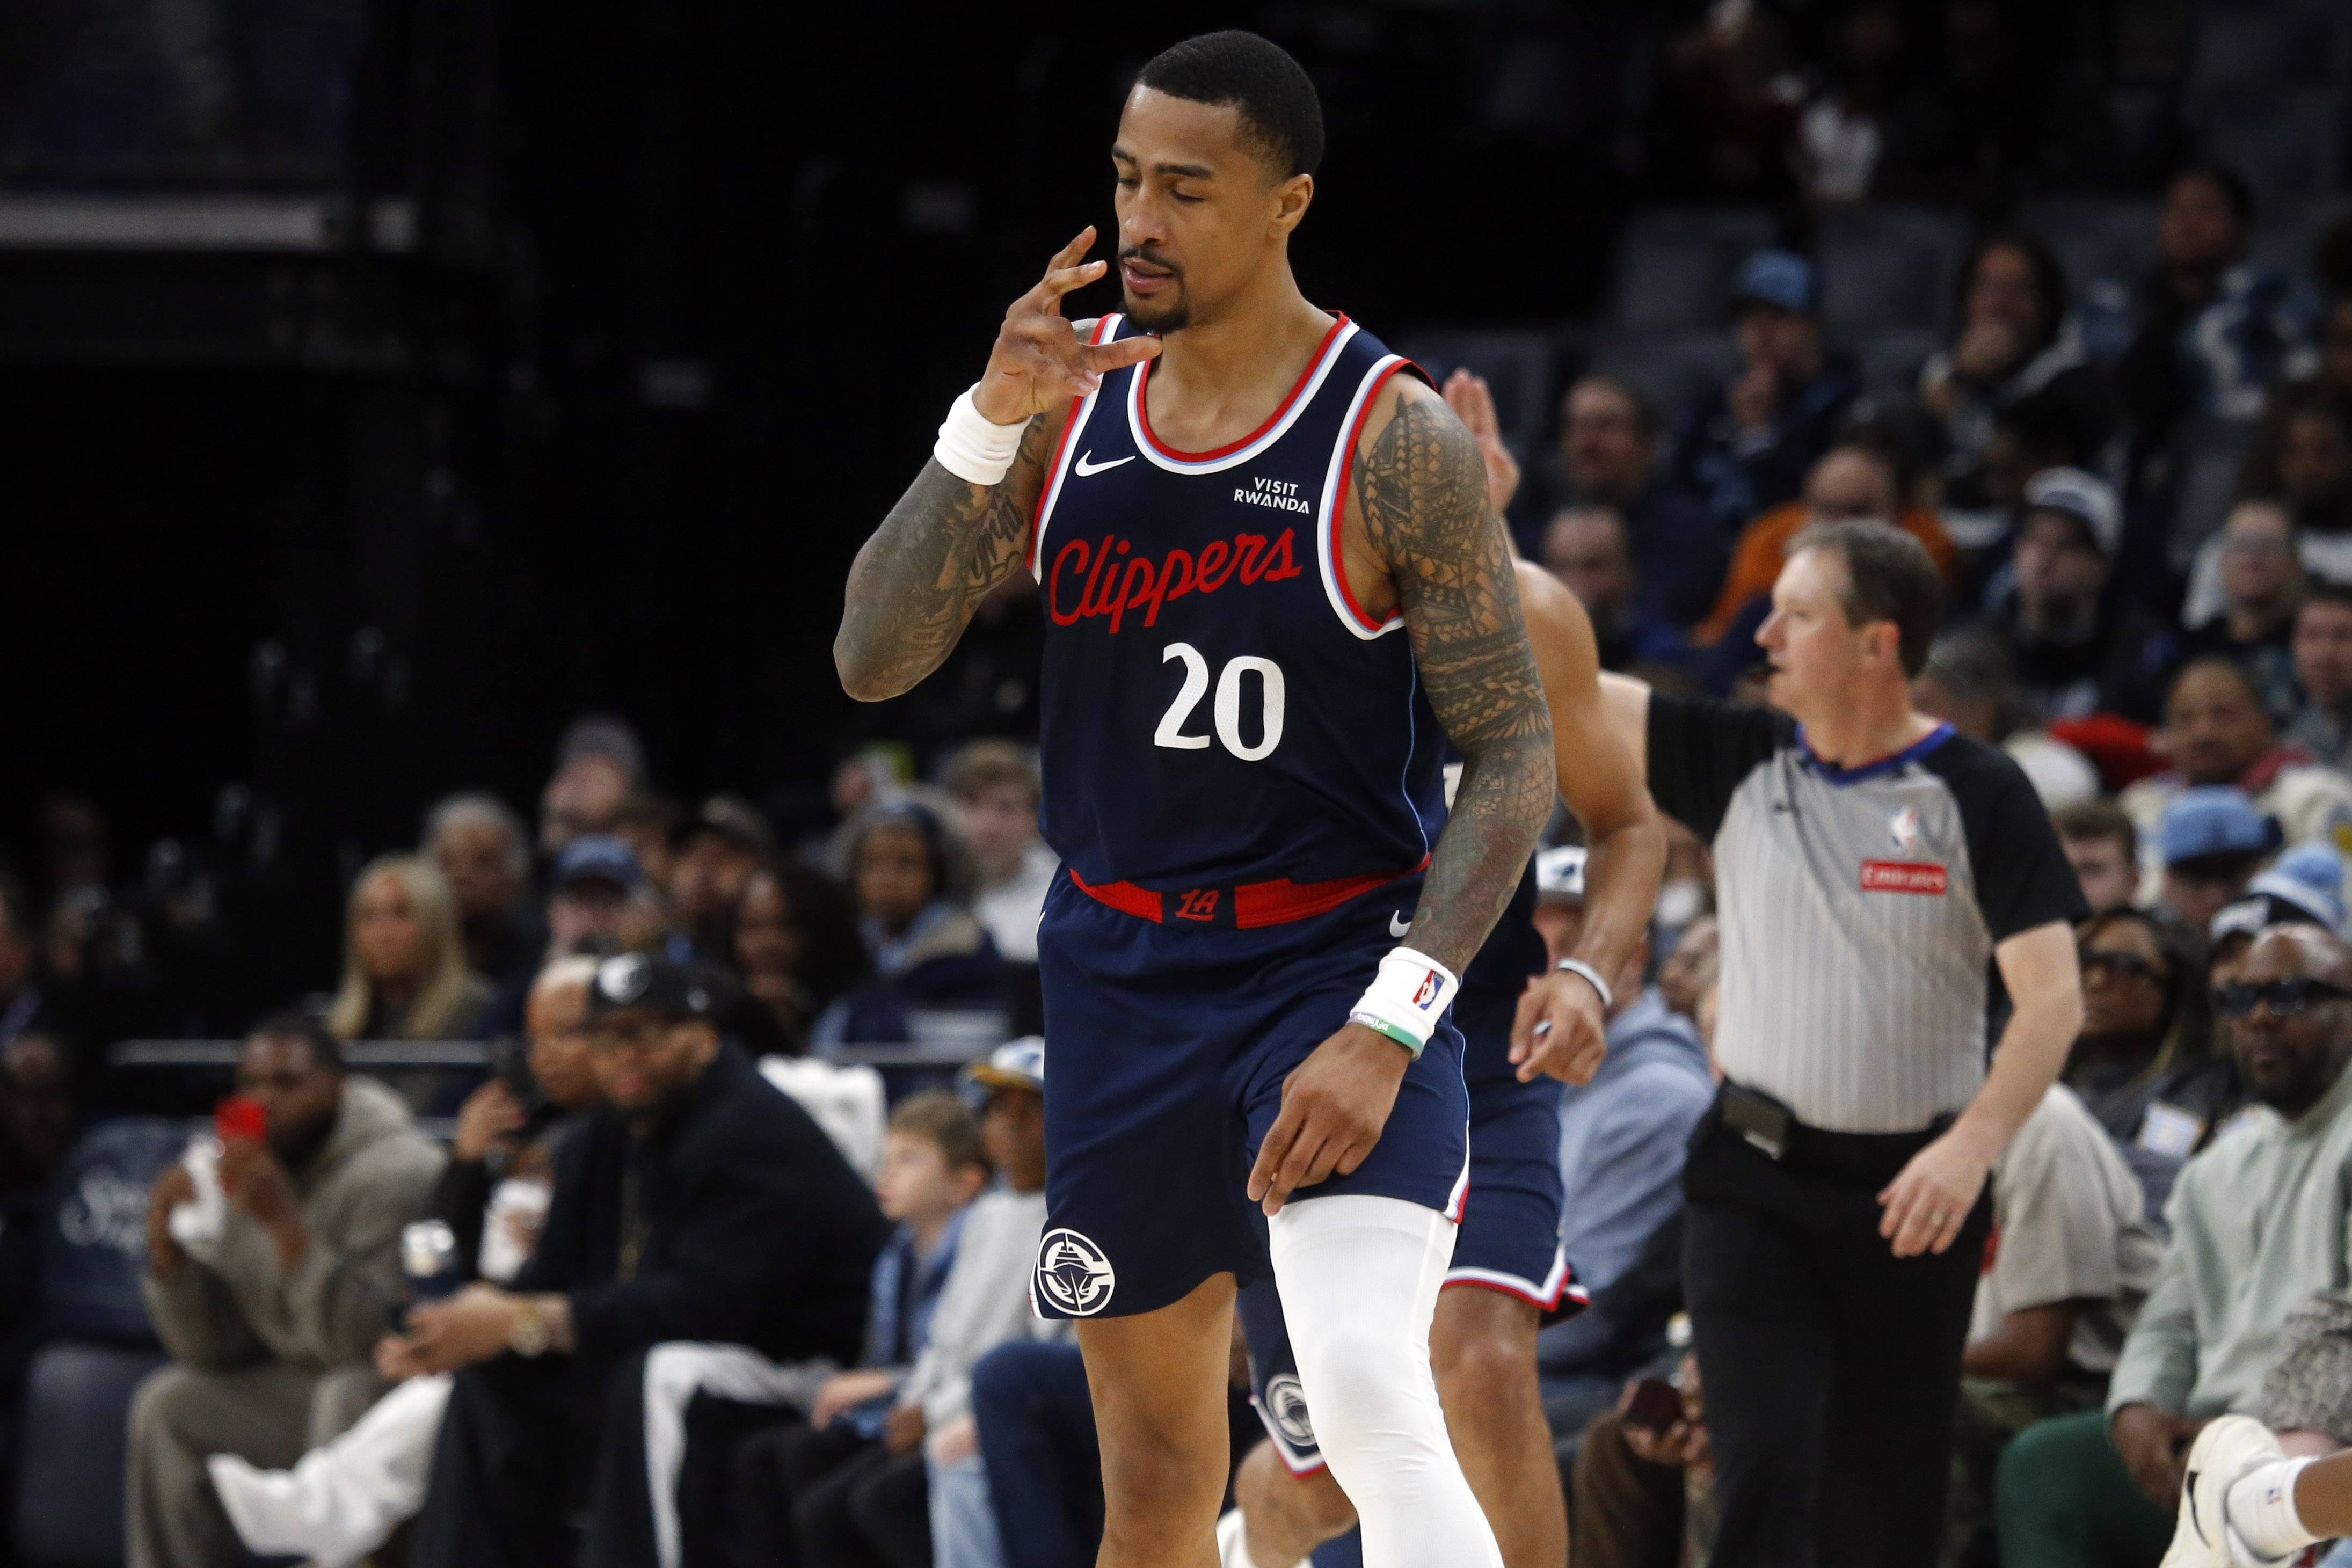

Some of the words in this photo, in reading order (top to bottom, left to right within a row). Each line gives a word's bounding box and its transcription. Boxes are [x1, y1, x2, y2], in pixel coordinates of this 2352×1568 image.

[1234, 488, 1309, 514] RWANDA
[1254, 477, 1299, 497] VISIT
[1049, 527, 1303, 635] Clippers
[1154, 642, 1285, 762] 20
[1175, 889, 1220, 922] LA
